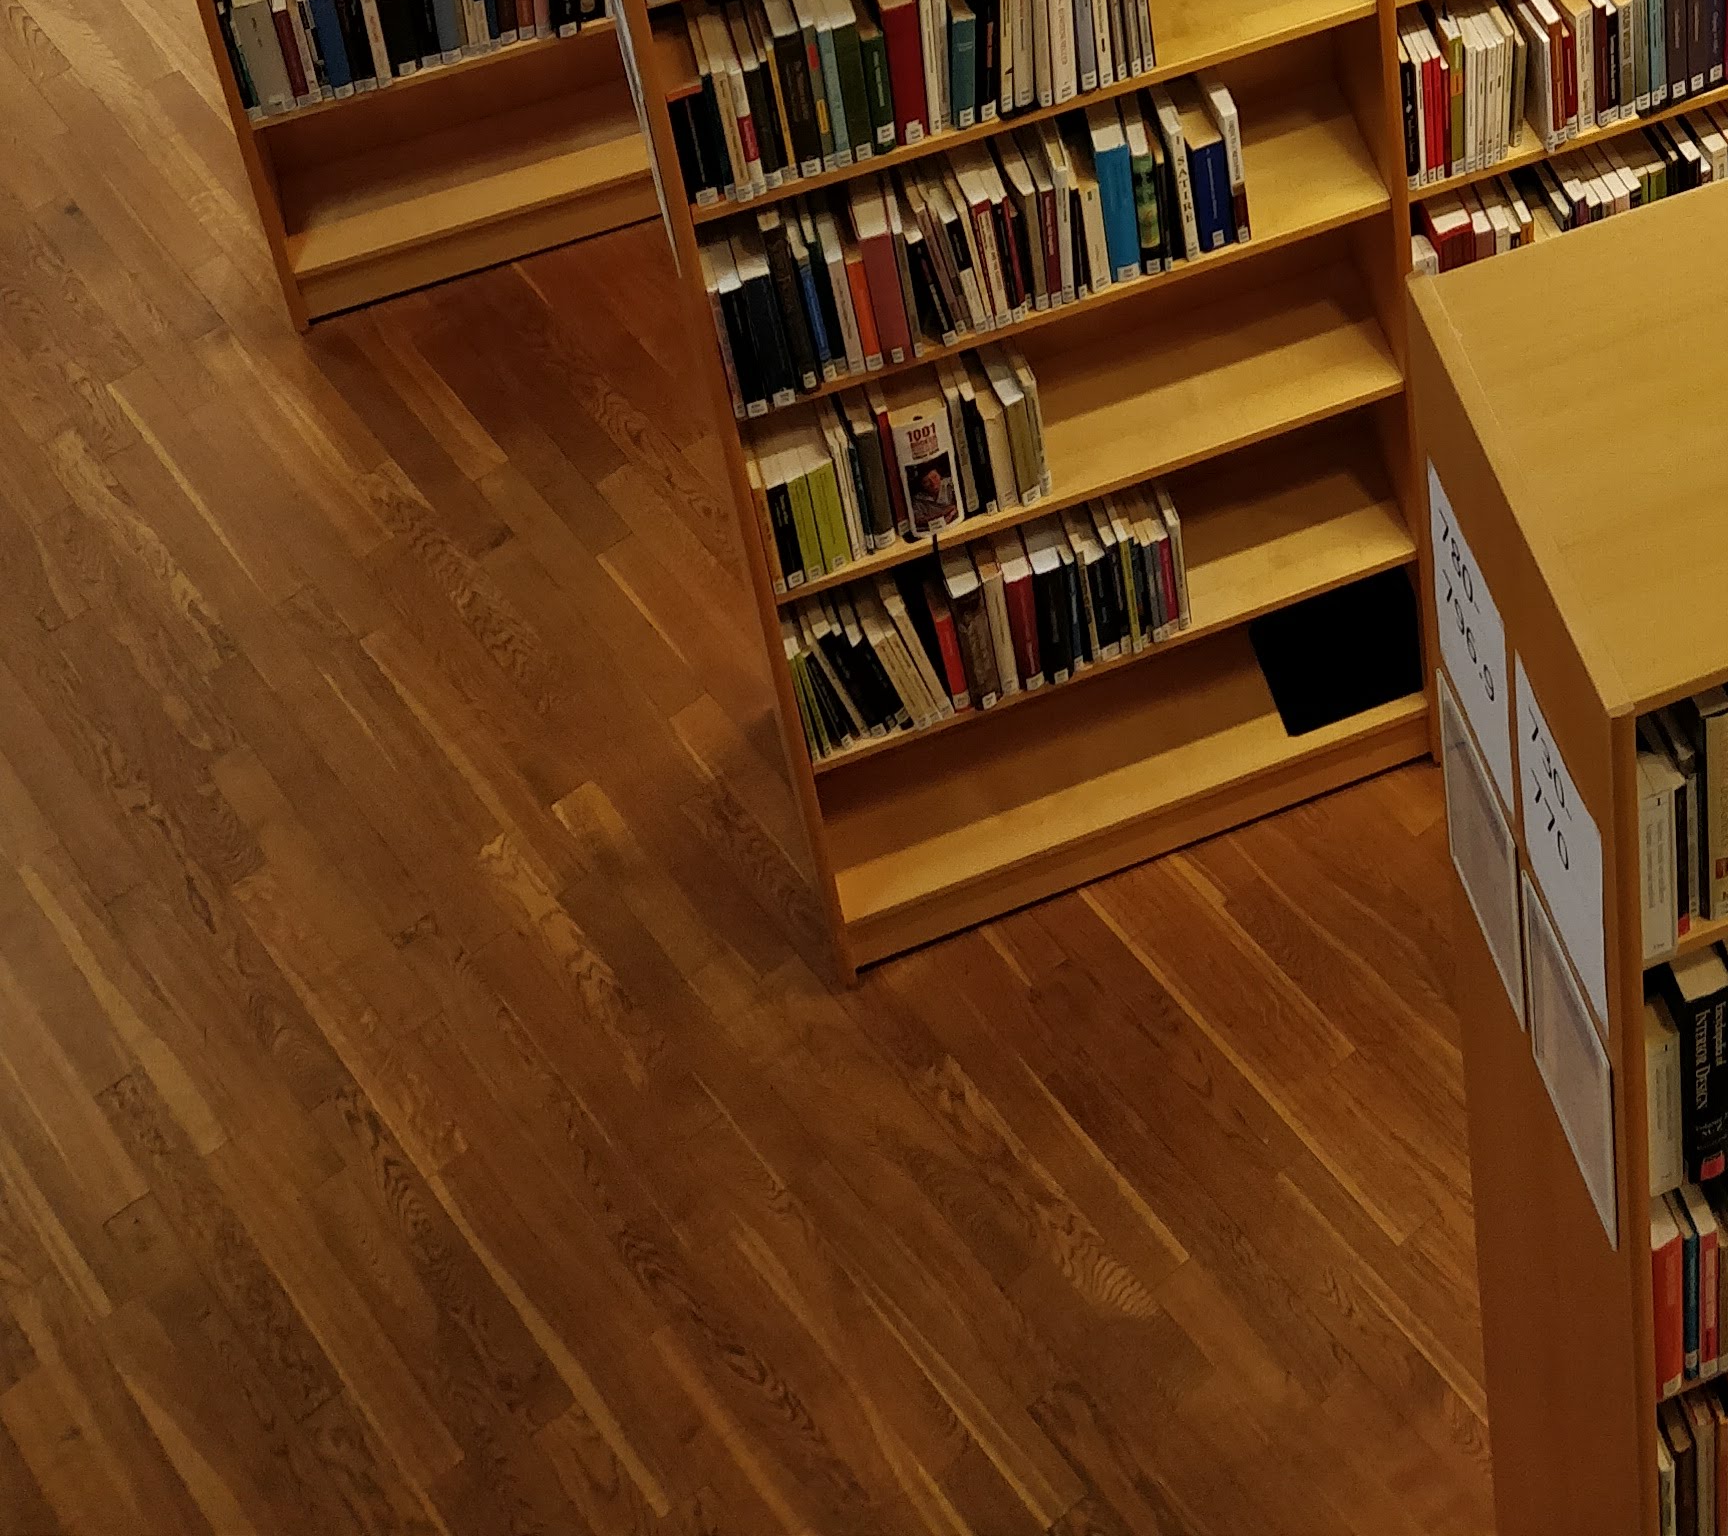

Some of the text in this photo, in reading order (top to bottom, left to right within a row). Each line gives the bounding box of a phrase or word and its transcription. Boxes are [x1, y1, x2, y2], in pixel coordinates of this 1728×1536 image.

[906, 422, 936, 442] 1001
[1438, 507, 1481, 615] 780-
[1442, 568, 1495, 702] 796.9
[1528, 705, 1573, 822] 730-
[1530, 767, 1570, 871] 770
[1694, 1063, 1709, 1111] DESIGN
